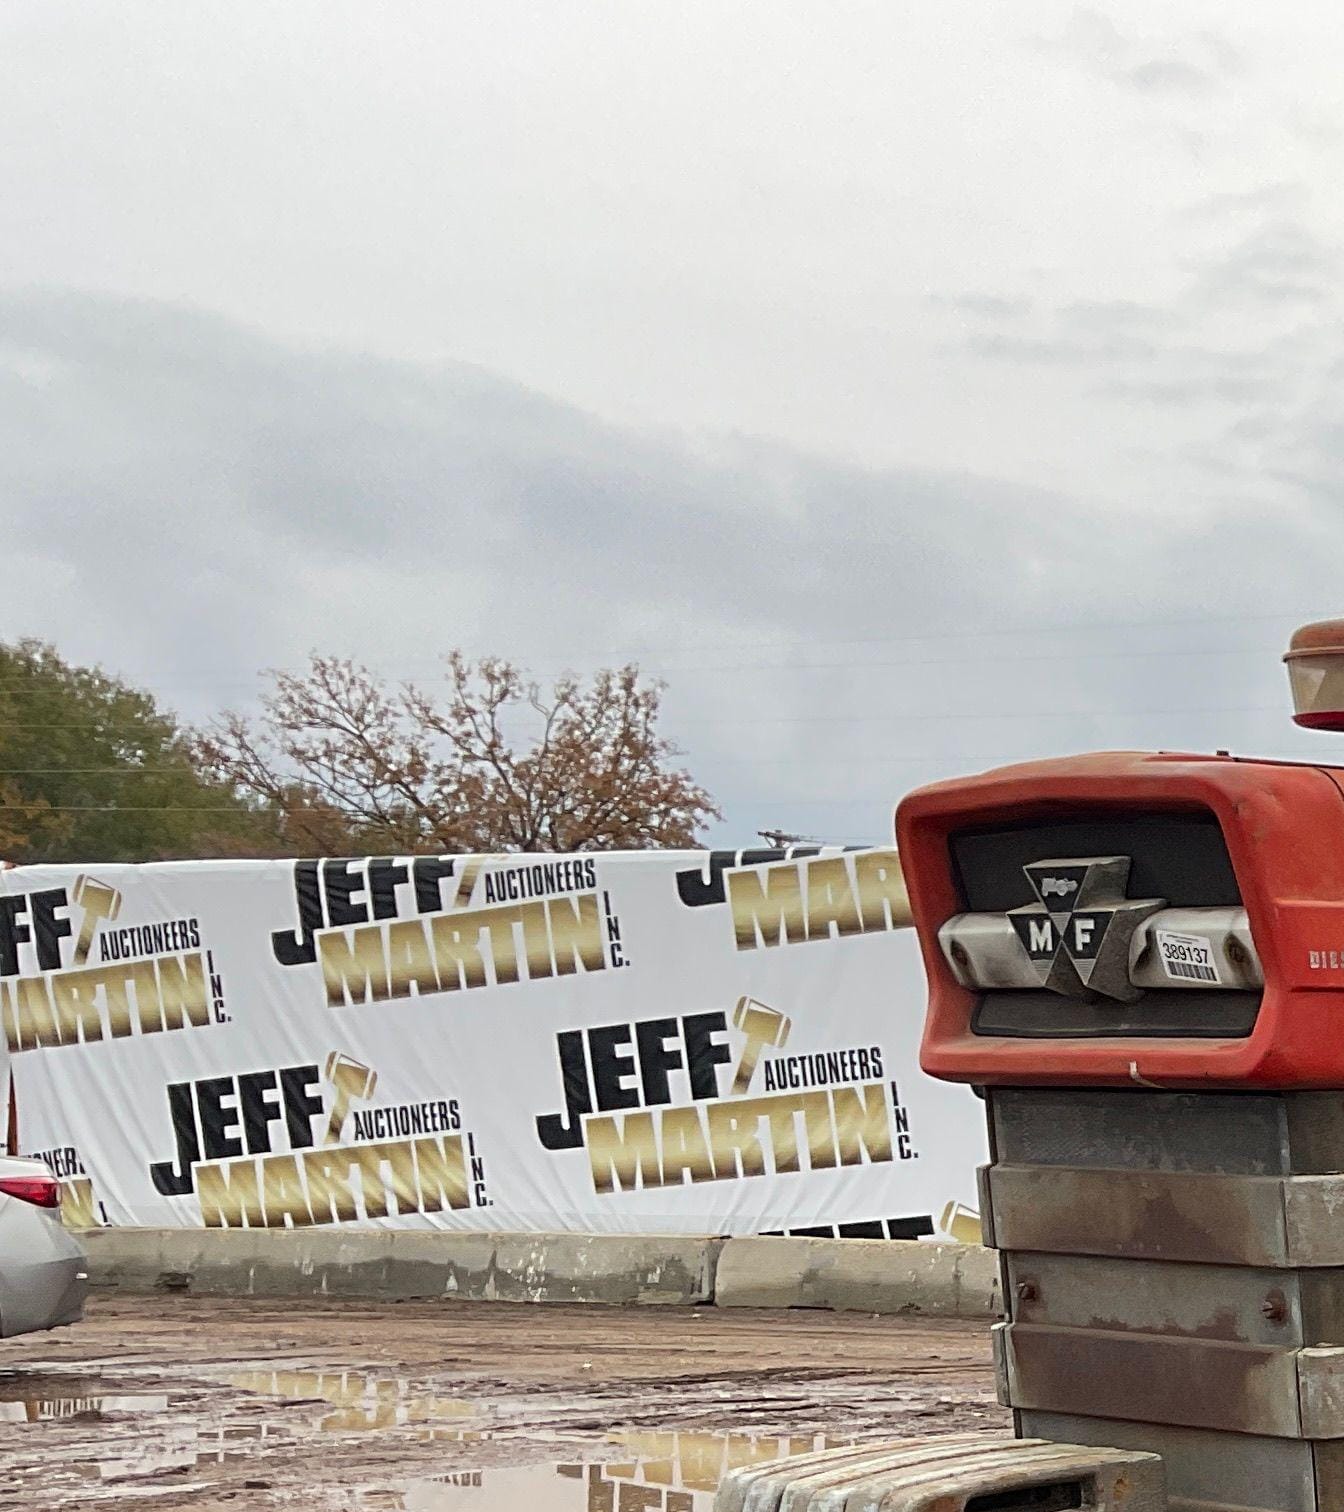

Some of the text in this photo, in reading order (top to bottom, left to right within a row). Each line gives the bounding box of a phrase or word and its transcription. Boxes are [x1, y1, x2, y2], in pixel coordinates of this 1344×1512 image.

[484, 858, 597, 903] AUCTIONEERS
[100, 918, 201, 963] AUCTIONEERS
[318, 892, 605, 1009] MARTIN
[1162, 942, 1208, 964] 389137
[0, 952, 211, 1053] ARTIN
[534, 1010, 732, 1151] JEFF
[763, 1046, 884, 1091] AUCTIONEERS
[150, 1064, 325, 1196] JEFF
[353, 1098, 462, 1142] AUCTIONEERS
[584, 1082, 894, 1195] MARTIN
[193, 1133, 472, 1228] MARTIN
